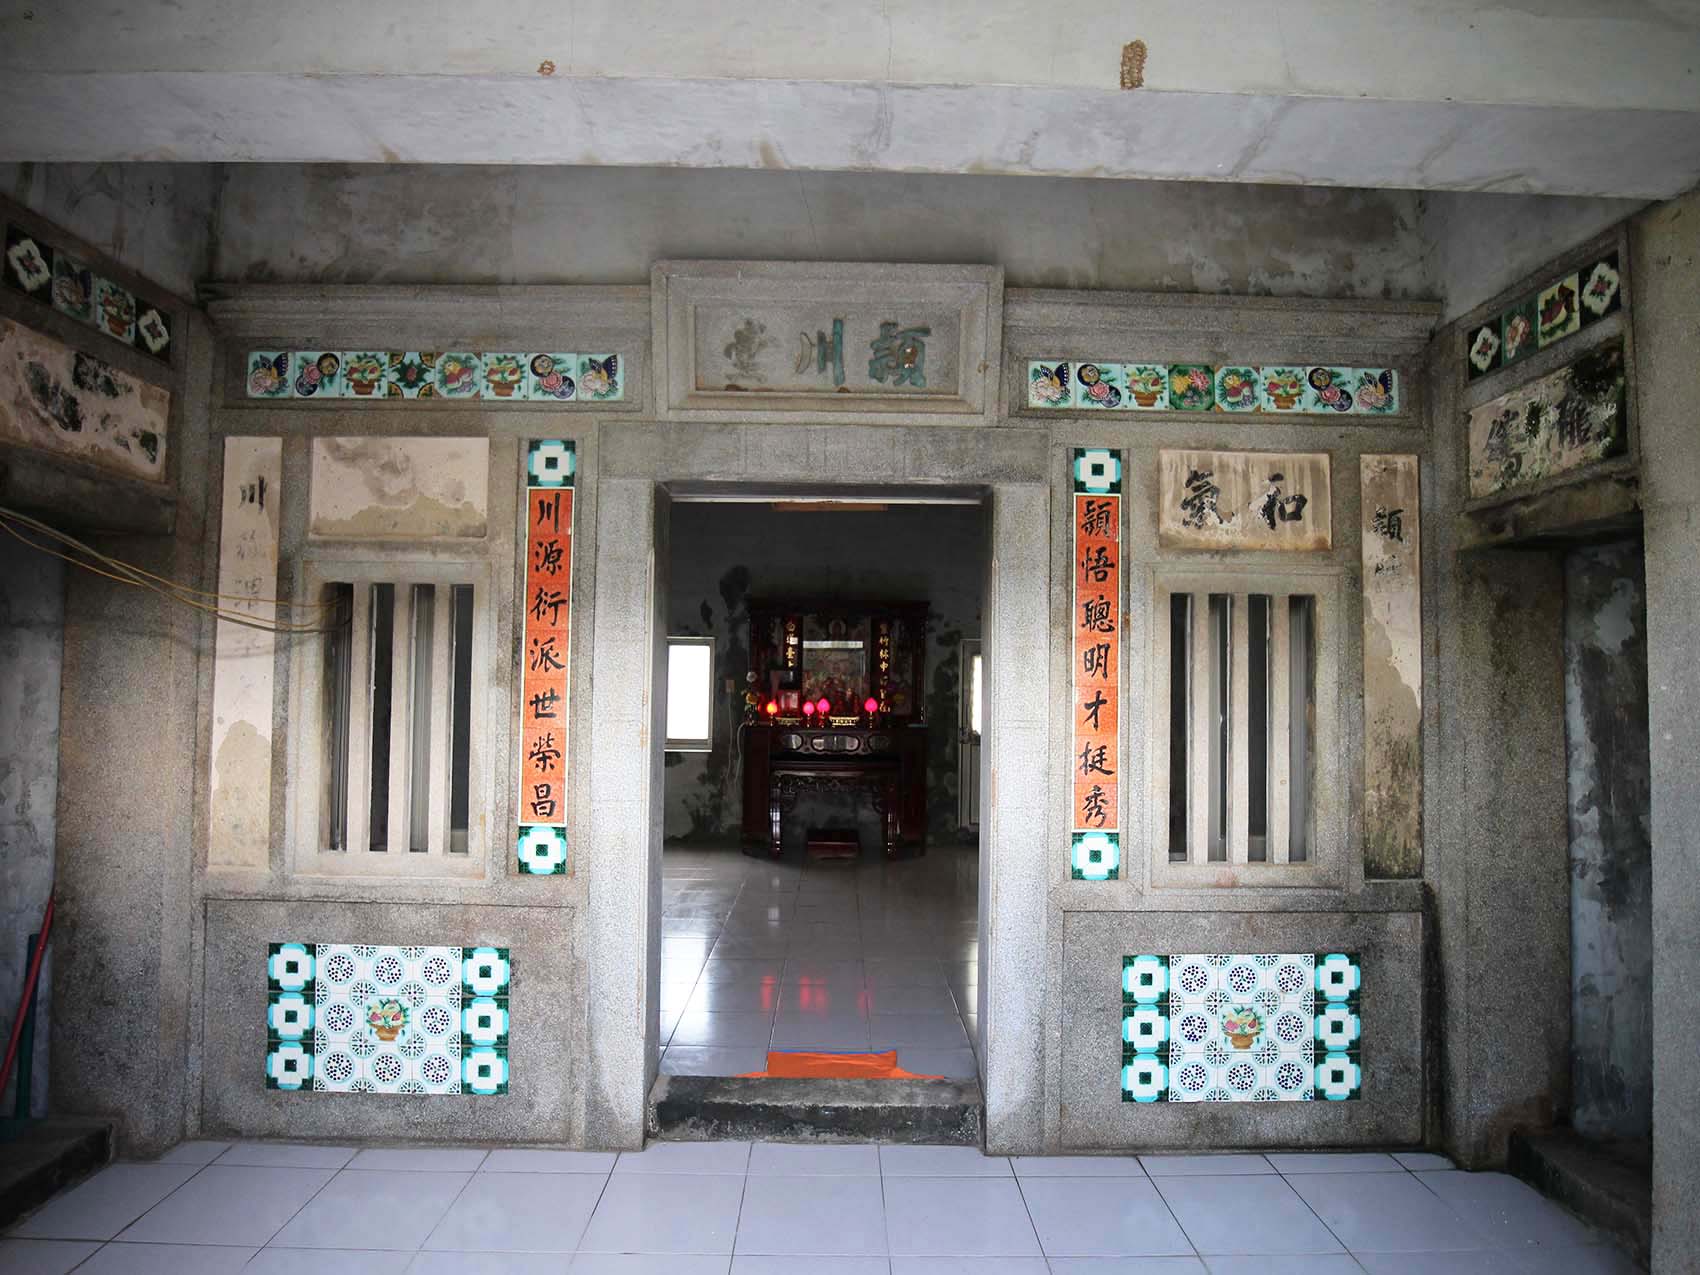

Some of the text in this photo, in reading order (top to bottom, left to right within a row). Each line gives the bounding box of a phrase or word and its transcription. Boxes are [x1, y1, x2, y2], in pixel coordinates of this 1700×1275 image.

[528, 494, 567, 818] 川源衍派世榮昌
